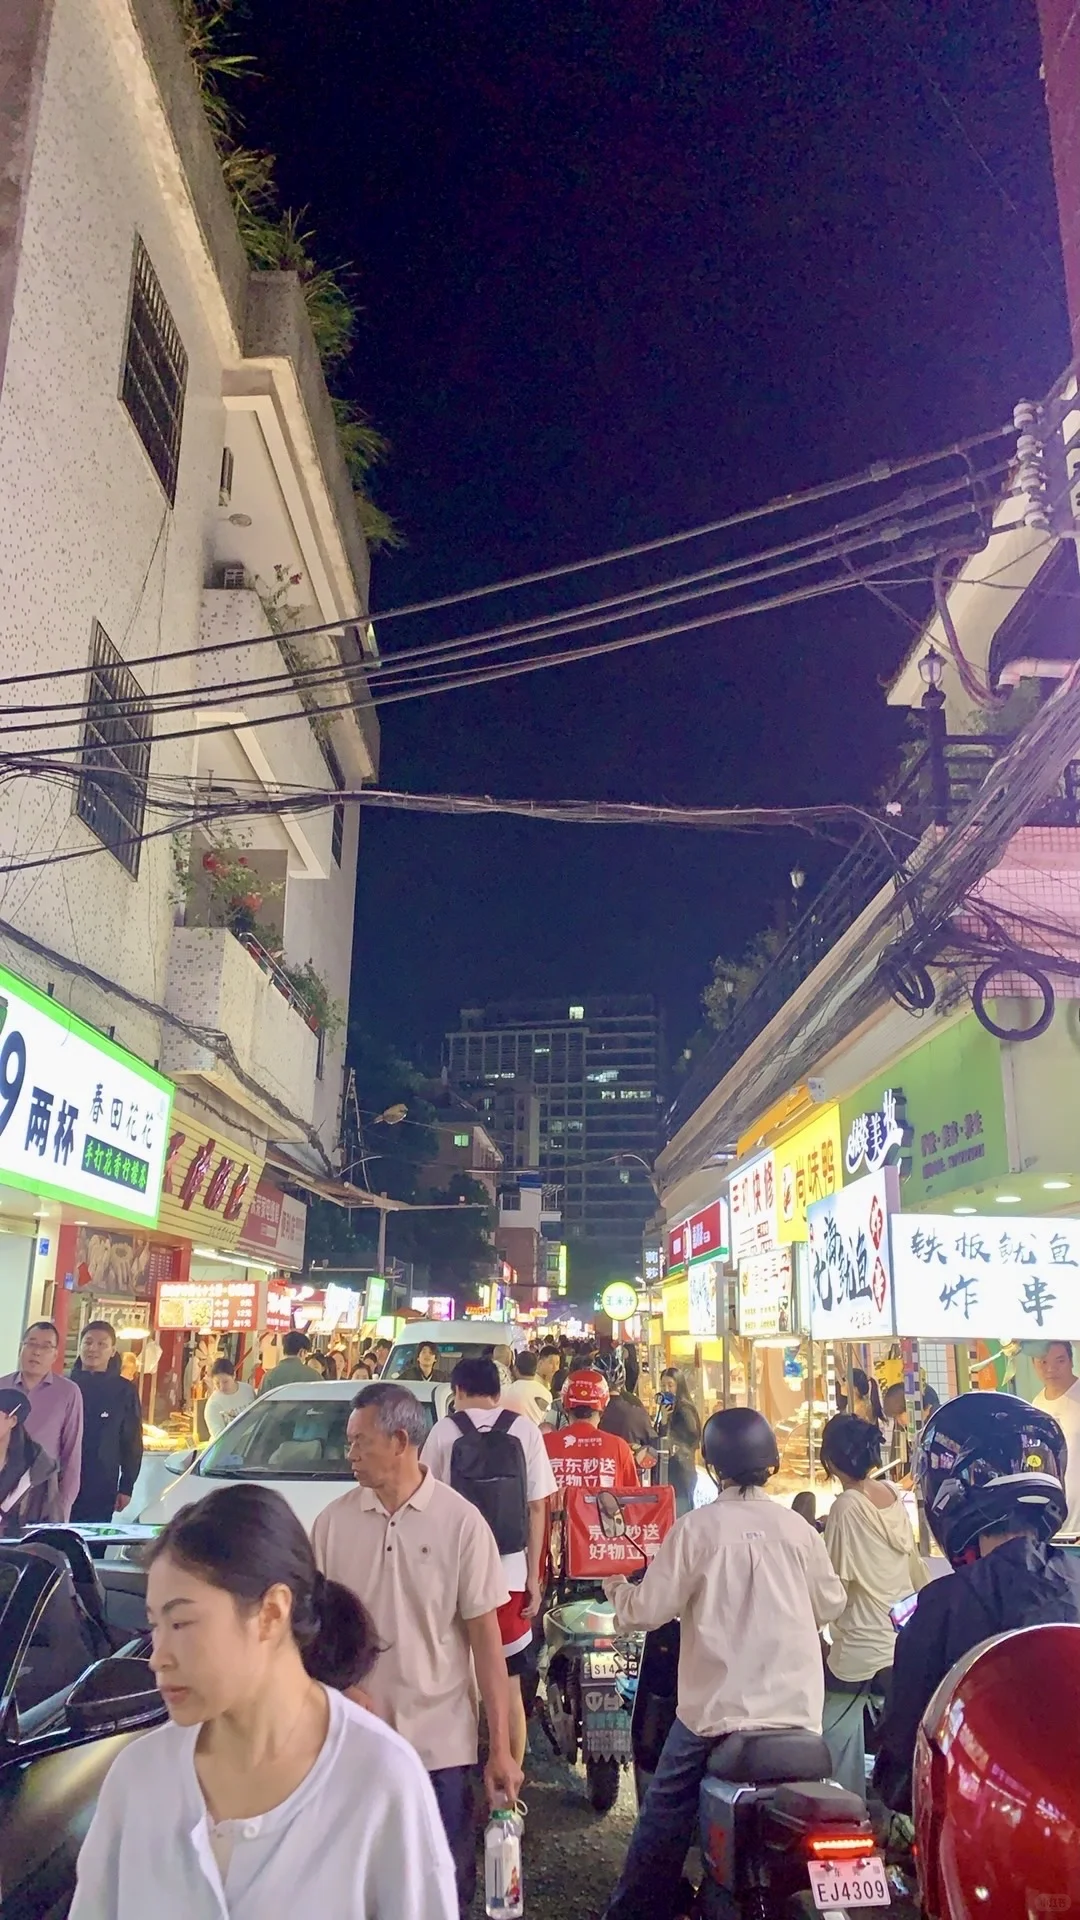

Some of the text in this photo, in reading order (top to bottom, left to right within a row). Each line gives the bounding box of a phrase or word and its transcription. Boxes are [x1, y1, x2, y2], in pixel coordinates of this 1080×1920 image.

[24, 1086, 79, 1166] 两杯
[89, 1083, 153, 1149] 春田花花
[85, 1139, 147, 1190] 手打花香柠檬茶
[910, 1227, 1079, 1267] 铁板鱿鱼
[606, 1295, 635, 1307] 玉米汁
[939, 1274, 1057, 1327] 炸串
[550, 1458, 616, 1474] 京东秒送
[588, 1523, 660, 1541] 京秒送
[817, 1880, 884, 1902] EJ4309
